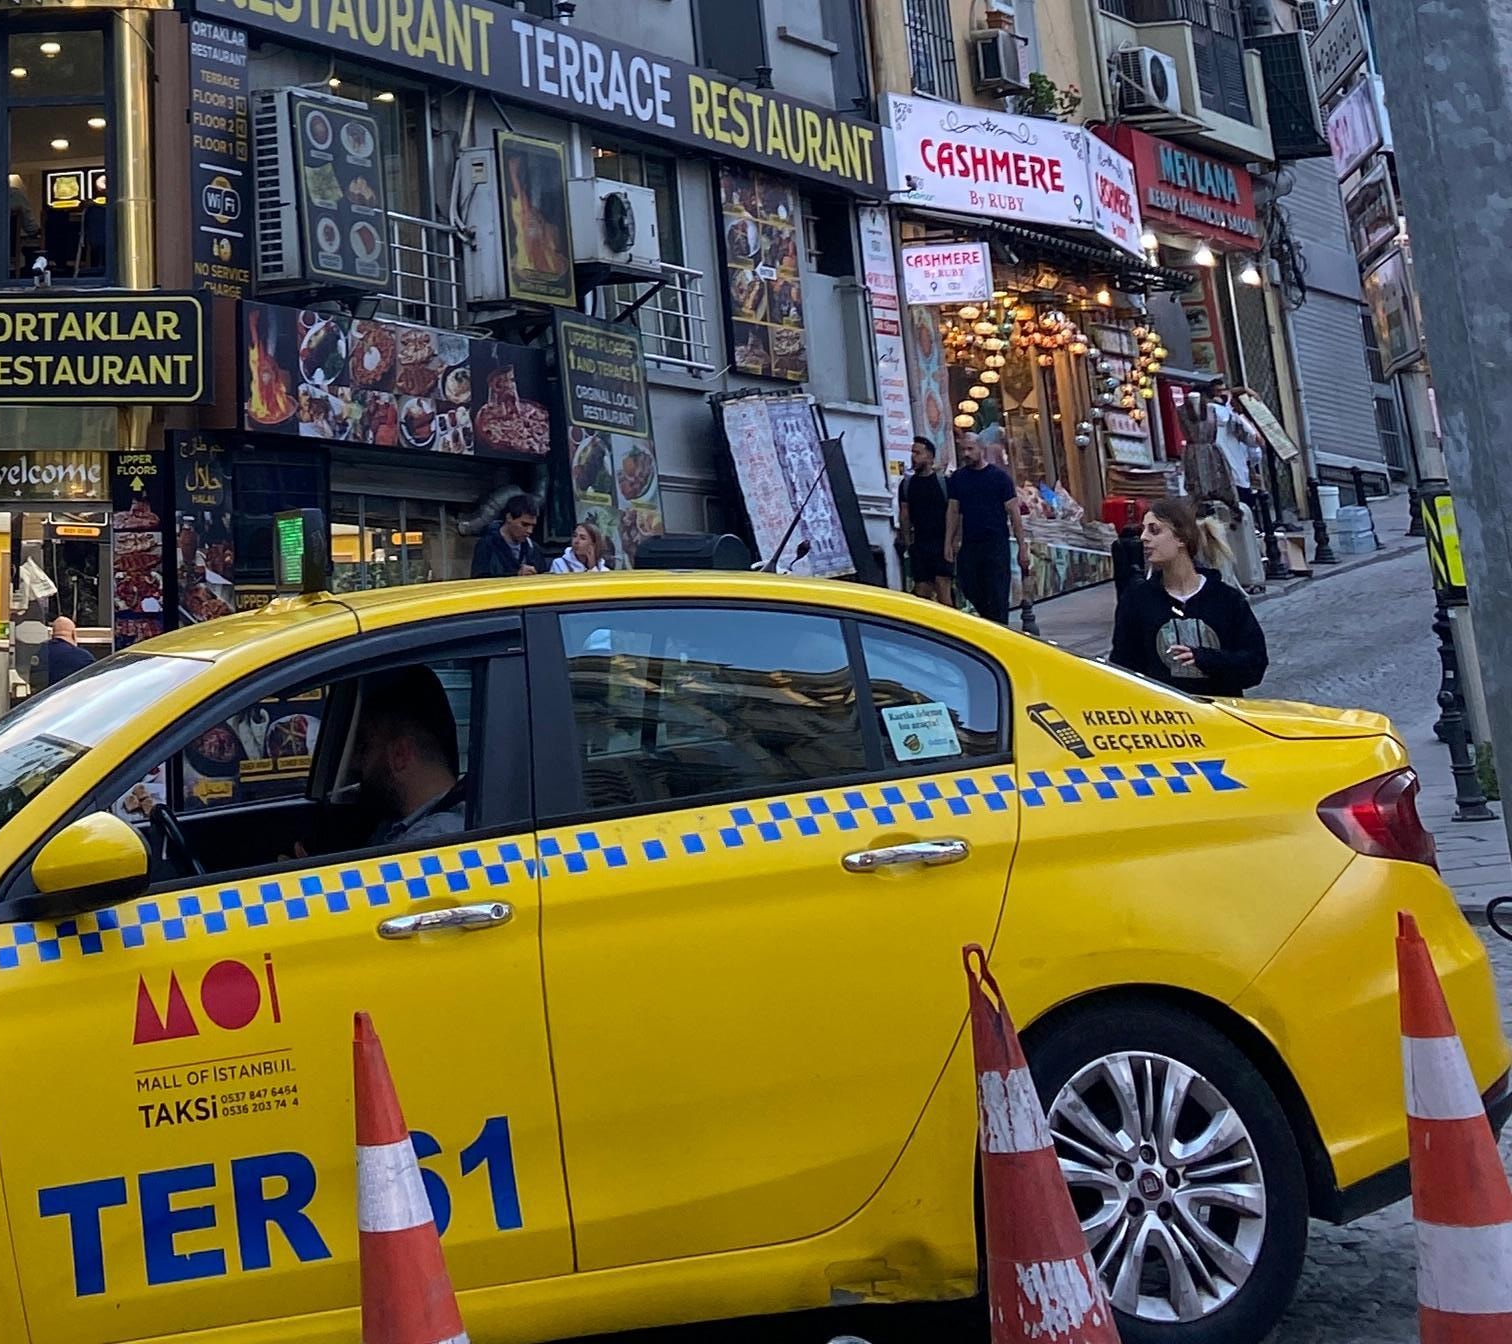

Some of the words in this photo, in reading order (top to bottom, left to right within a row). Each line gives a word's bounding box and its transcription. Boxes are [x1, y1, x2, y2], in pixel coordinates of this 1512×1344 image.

[191, 20, 246, 47] ORTAKLAR
[191, 42, 246, 67] RESTAURANT
[200, 69, 240, 90] TERRACE
[192, 89, 226, 108] FLOOR
[228, 97, 234, 110] 3
[511, 19, 676, 129] TERRACE
[688, 74, 874, 184] RESTAURANT
[193, 112, 227, 131] FLOOR
[228, 119, 235, 133] 2
[193, 134, 227, 154] FLOOR
[228, 142, 233, 155] 1
[920, 139, 1064, 194] CASHMERE
[969, 190, 984, 209] By
[988, 193, 1024, 212] RUBY
[906, 251, 980, 268] CASHMERE
[194, 262, 209, 276] NO
[211, 265, 250, 283] SERVICE
[938, 267, 965, 278] RUBY
[119, 454, 152, 465] UPPER
[116, 465, 157, 476] FLOORS
[236, 594, 268, 608] UPPER
[1083, 706, 1138, 726] KREDİ
[1143, 710, 1195, 725] KARTI
[1093, 729, 1206, 754] GEÇERLİDİR
[137, 1074, 182, 1092] MALL
[187, 1069, 209, 1086] OF
[221, 1092, 246, 1104] 0537
[249, 1088, 268, 1100] 847
[222, 1105, 249, 1117] 0536
[252, 1102, 272, 1113] 203
[39, 1150, 333, 1298] TER
